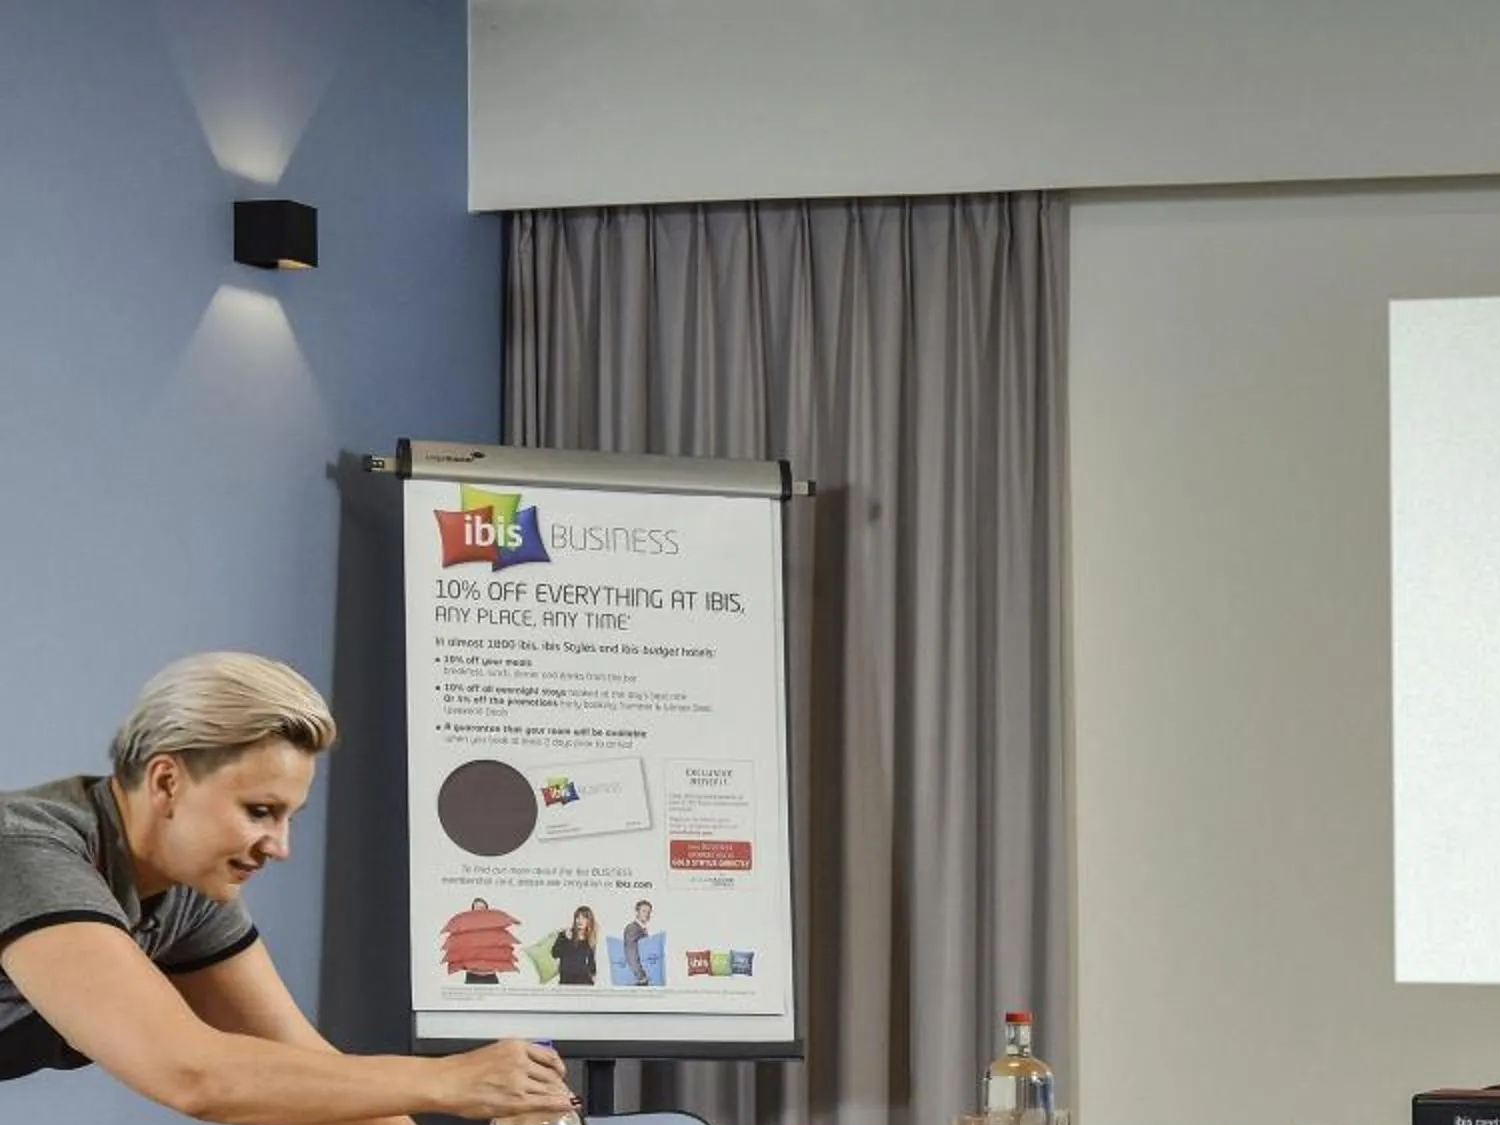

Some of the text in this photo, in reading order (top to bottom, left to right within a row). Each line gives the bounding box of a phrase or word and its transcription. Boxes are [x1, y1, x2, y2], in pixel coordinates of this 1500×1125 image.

[463, 514, 679, 556] ibis BUSINESS
[435, 579, 745, 615] 10% OFF EVERYTHING AT IBIS,
[435, 605, 471, 623] ANY
[477, 607, 537, 627] PLACE,
[543, 610, 579, 628] ANY
[447, 637, 485, 649] almost
[541, 640, 561, 652] ibis
[563, 641, 596, 654] Styles
[599, 643, 619, 654] and
[621, 644, 639, 655] ibis
[643, 644, 680, 659] budget
[466, 656, 479, 666] off
[481, 658, 503, 667] your
[466, 683, 480, 693] off
[473, 695, 487, 704] off
[592, 728, 604, 737] be
